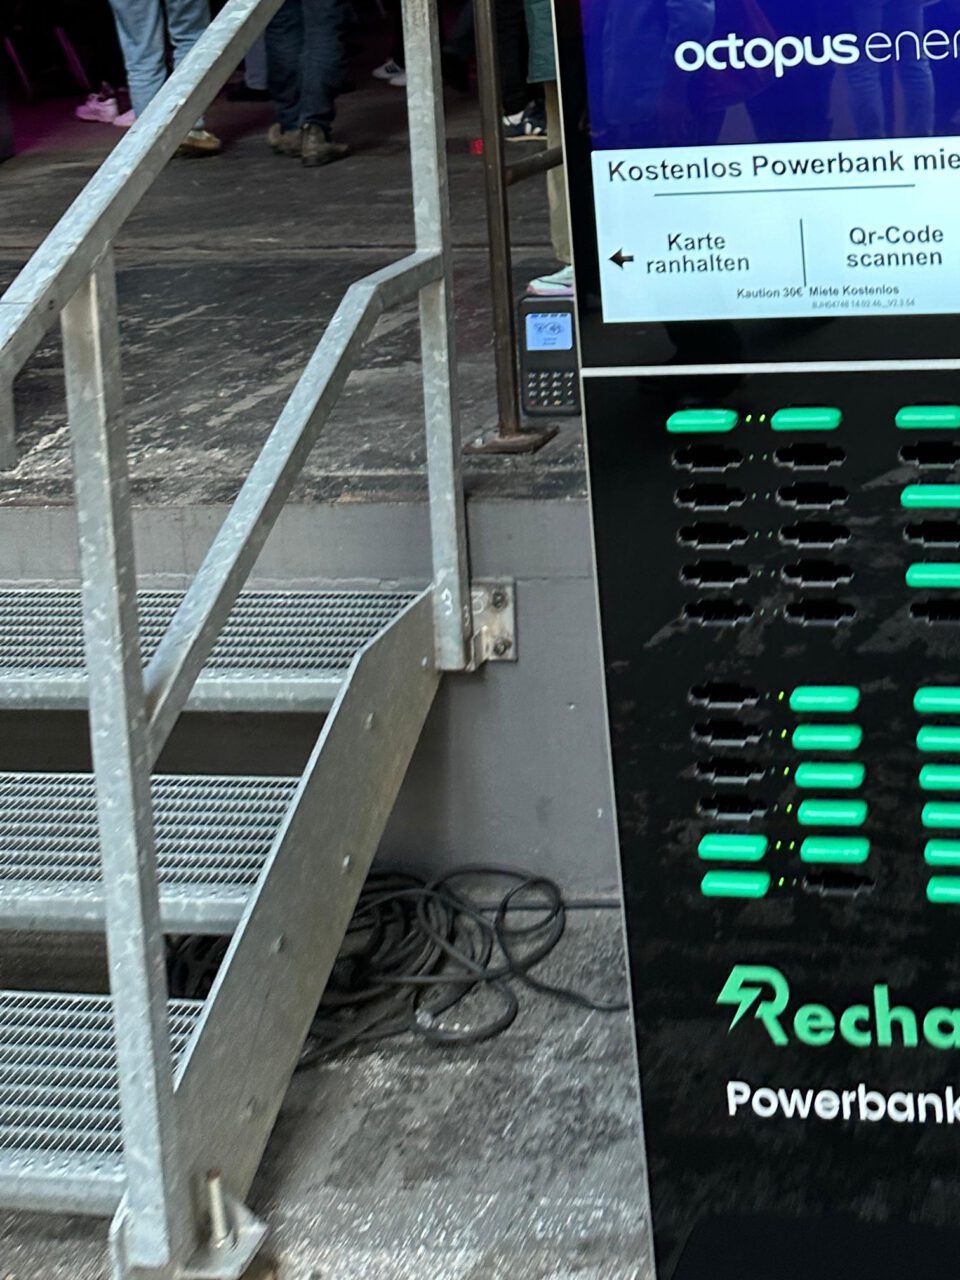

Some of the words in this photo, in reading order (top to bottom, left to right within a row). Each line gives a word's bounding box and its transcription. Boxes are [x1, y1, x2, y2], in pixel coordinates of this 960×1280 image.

[608, 158, 742, 182] Kostenlos
[752, 150, 904, 176] Powerbank
[667, 233, 726, 251] Karte
[849, 225, 945, 245] Qr-Code
[646, 254, 750, 274] ranhalten
[847, 251, 943, 268] scannen
[736, 288, 780, 299] Kaution
[809, 286, 839, 297] Miete
[842, 284, 900, 296] Kostenlos
